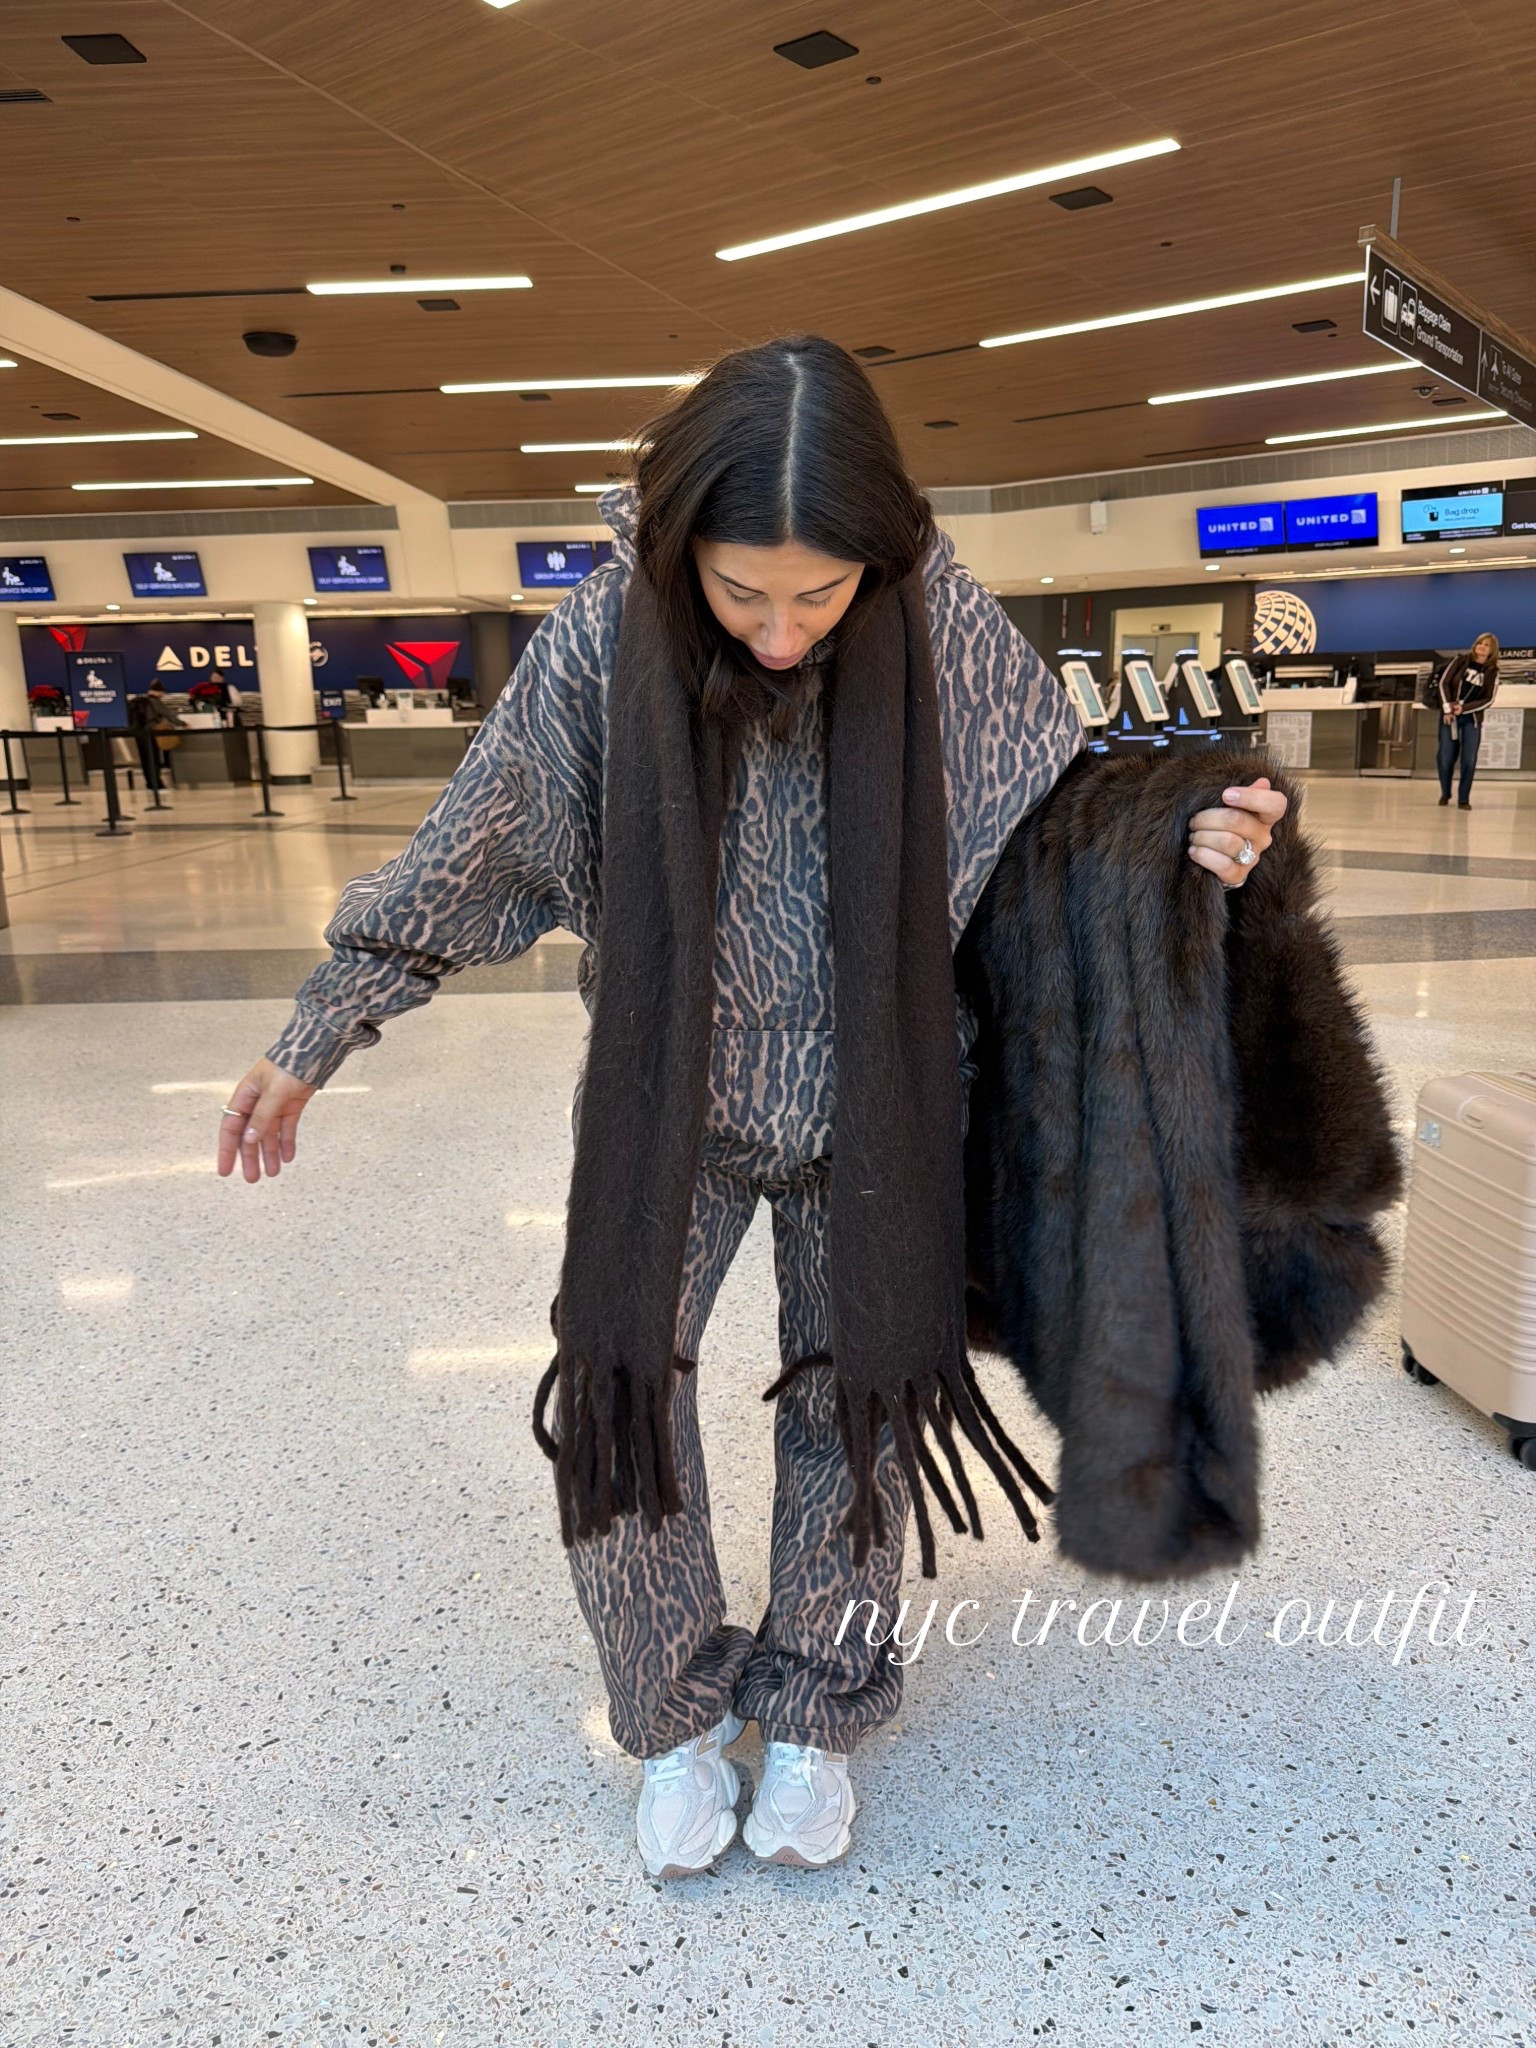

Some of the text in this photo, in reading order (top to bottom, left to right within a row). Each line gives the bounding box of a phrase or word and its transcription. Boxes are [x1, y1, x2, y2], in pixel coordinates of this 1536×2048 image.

[1418, 299, 1452, 334] Baggage Claim
[1417, 325, 1464, 366] Ground Transportation
[1444, 507, 1480, 517] Bag drop
[1296, 513, 1350, 527] UNITED
[1511, 522, 1524, 530] Get
[1208, 521, 1258, 534] UNITED
[189, 645, 258, 668] DEL
[1499, 649, 1534, 658] LIANCE
[323, 697, 342, 707] EXIT
